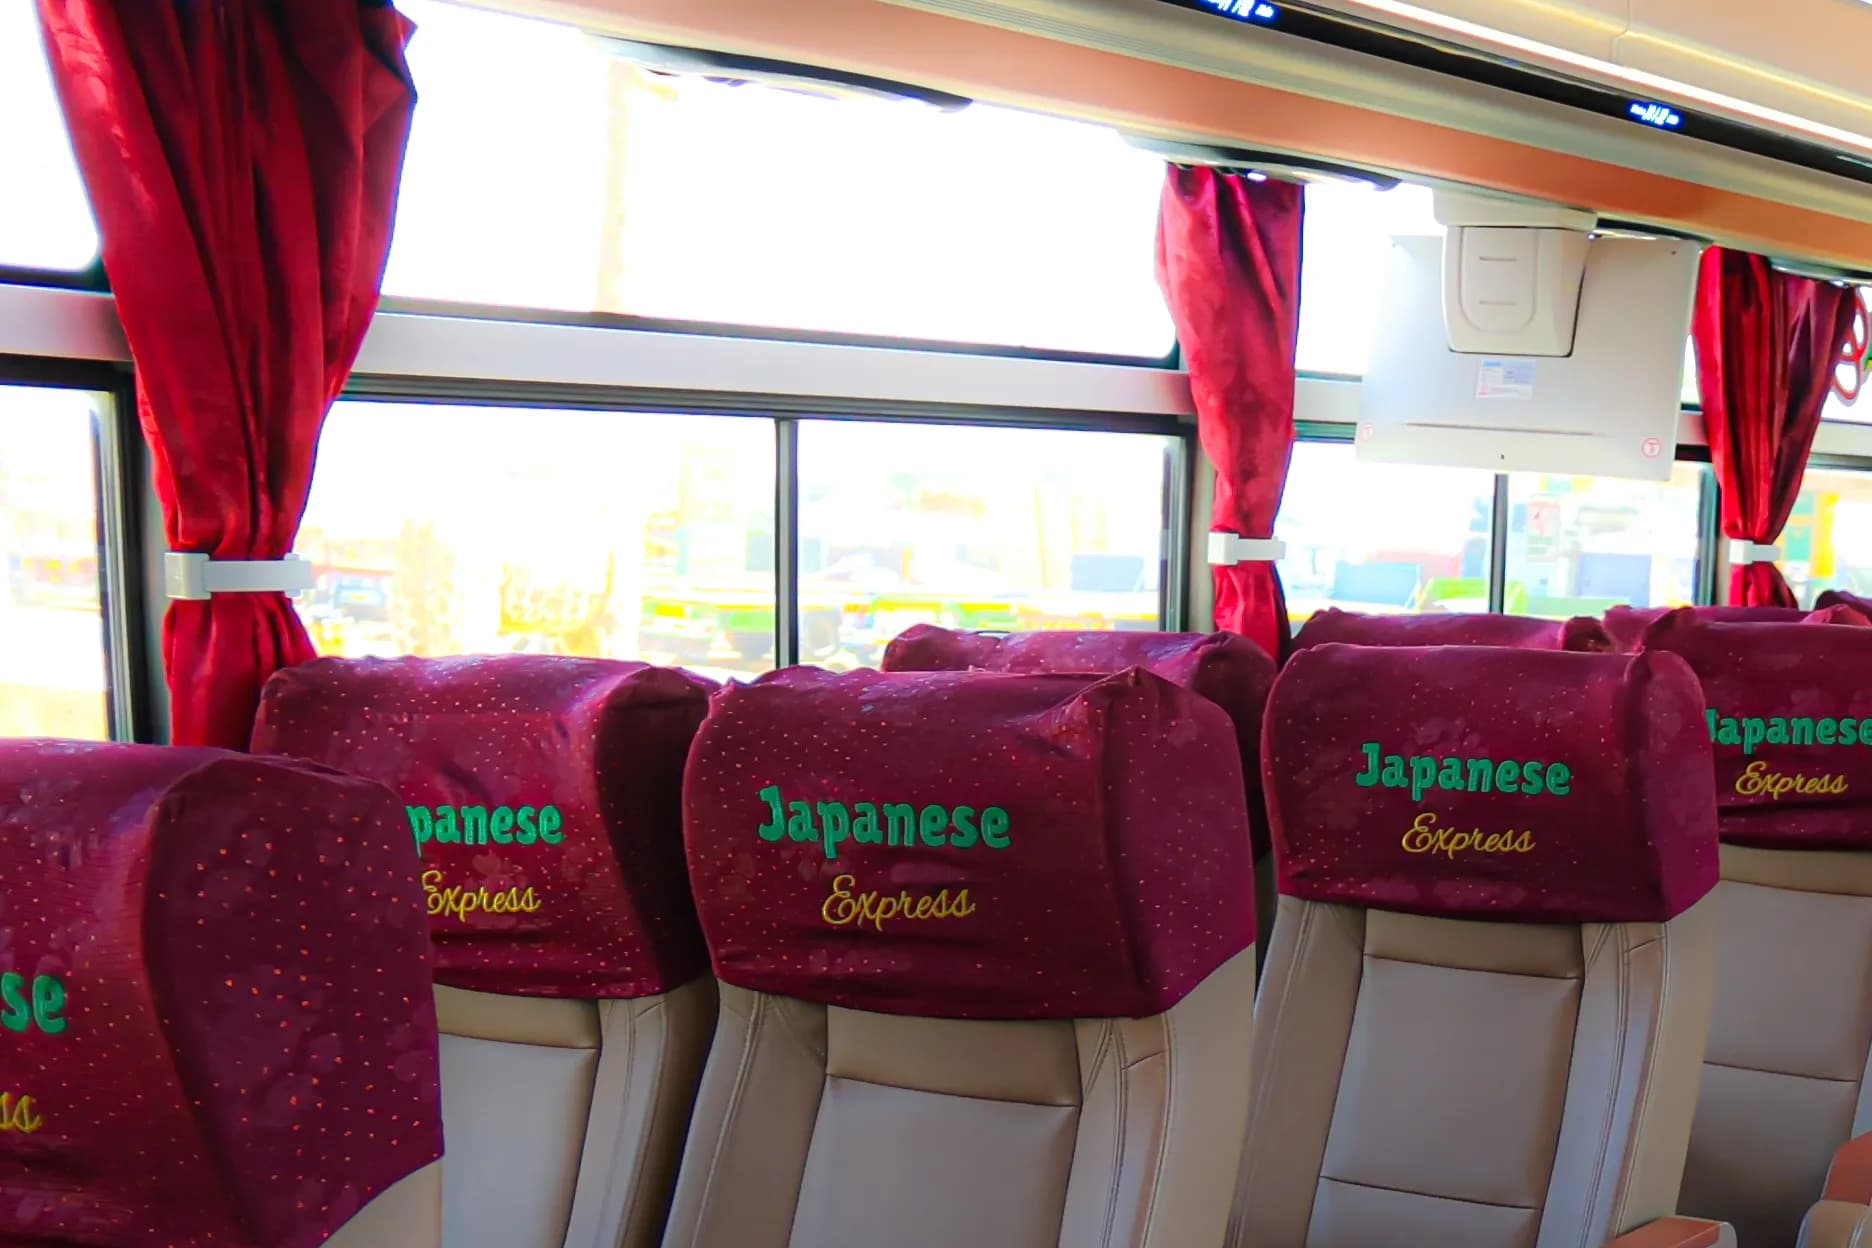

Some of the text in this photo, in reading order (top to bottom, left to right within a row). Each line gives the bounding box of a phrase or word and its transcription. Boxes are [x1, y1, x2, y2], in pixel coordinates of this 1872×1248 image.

[1355, 742, 1571, 801] Japanese
[1735, 761, 1848, 800] Express
[757, 785, 1012, 860] Japanese
[1402, 812, 1536, 860] Express
[421, 870, 542, 922] Express
[822, 874, 977, 931] Express
